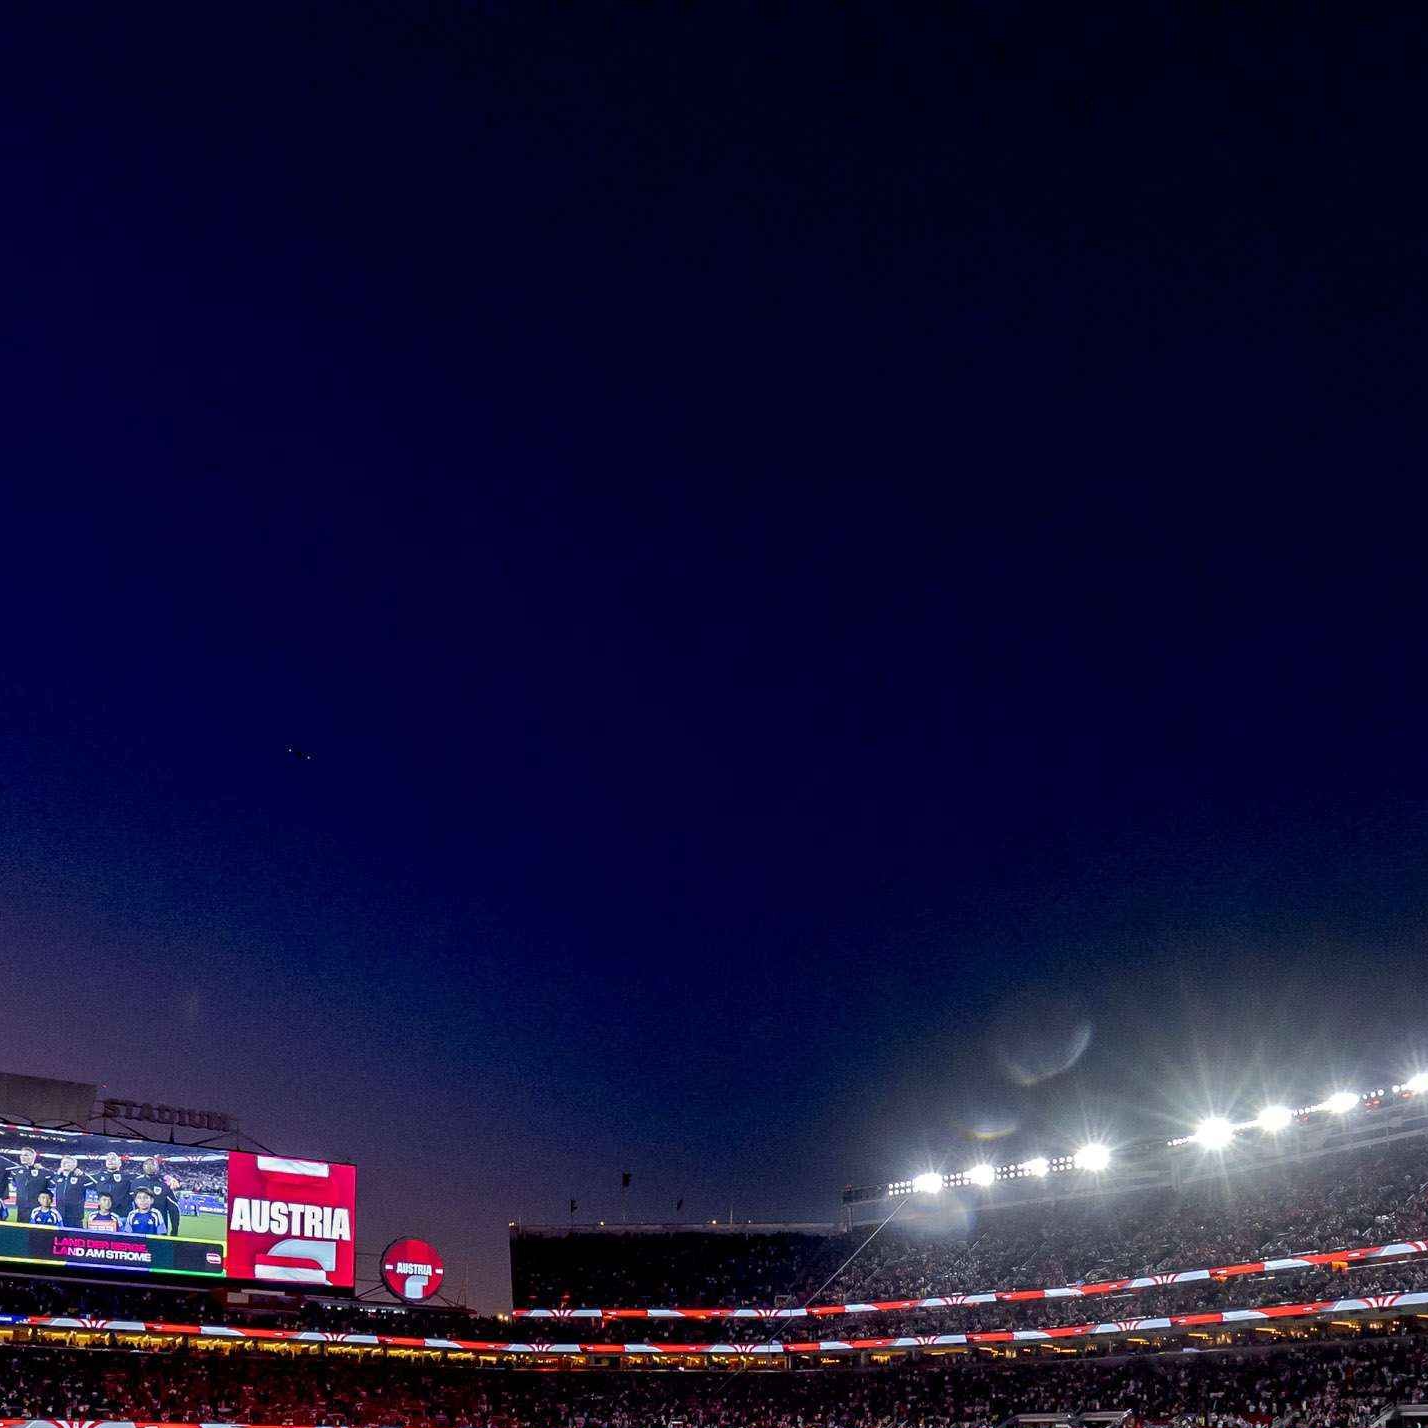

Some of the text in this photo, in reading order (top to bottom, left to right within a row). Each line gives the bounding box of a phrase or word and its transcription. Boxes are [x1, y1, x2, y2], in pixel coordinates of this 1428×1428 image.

[230, 1197, 351, 1241] AUSTRIA
[53, 1245, 85, 1257] LAND
[86, 1248, 105, 1259] AM
[396, 1262, 432, 1276] AUSTRIA
